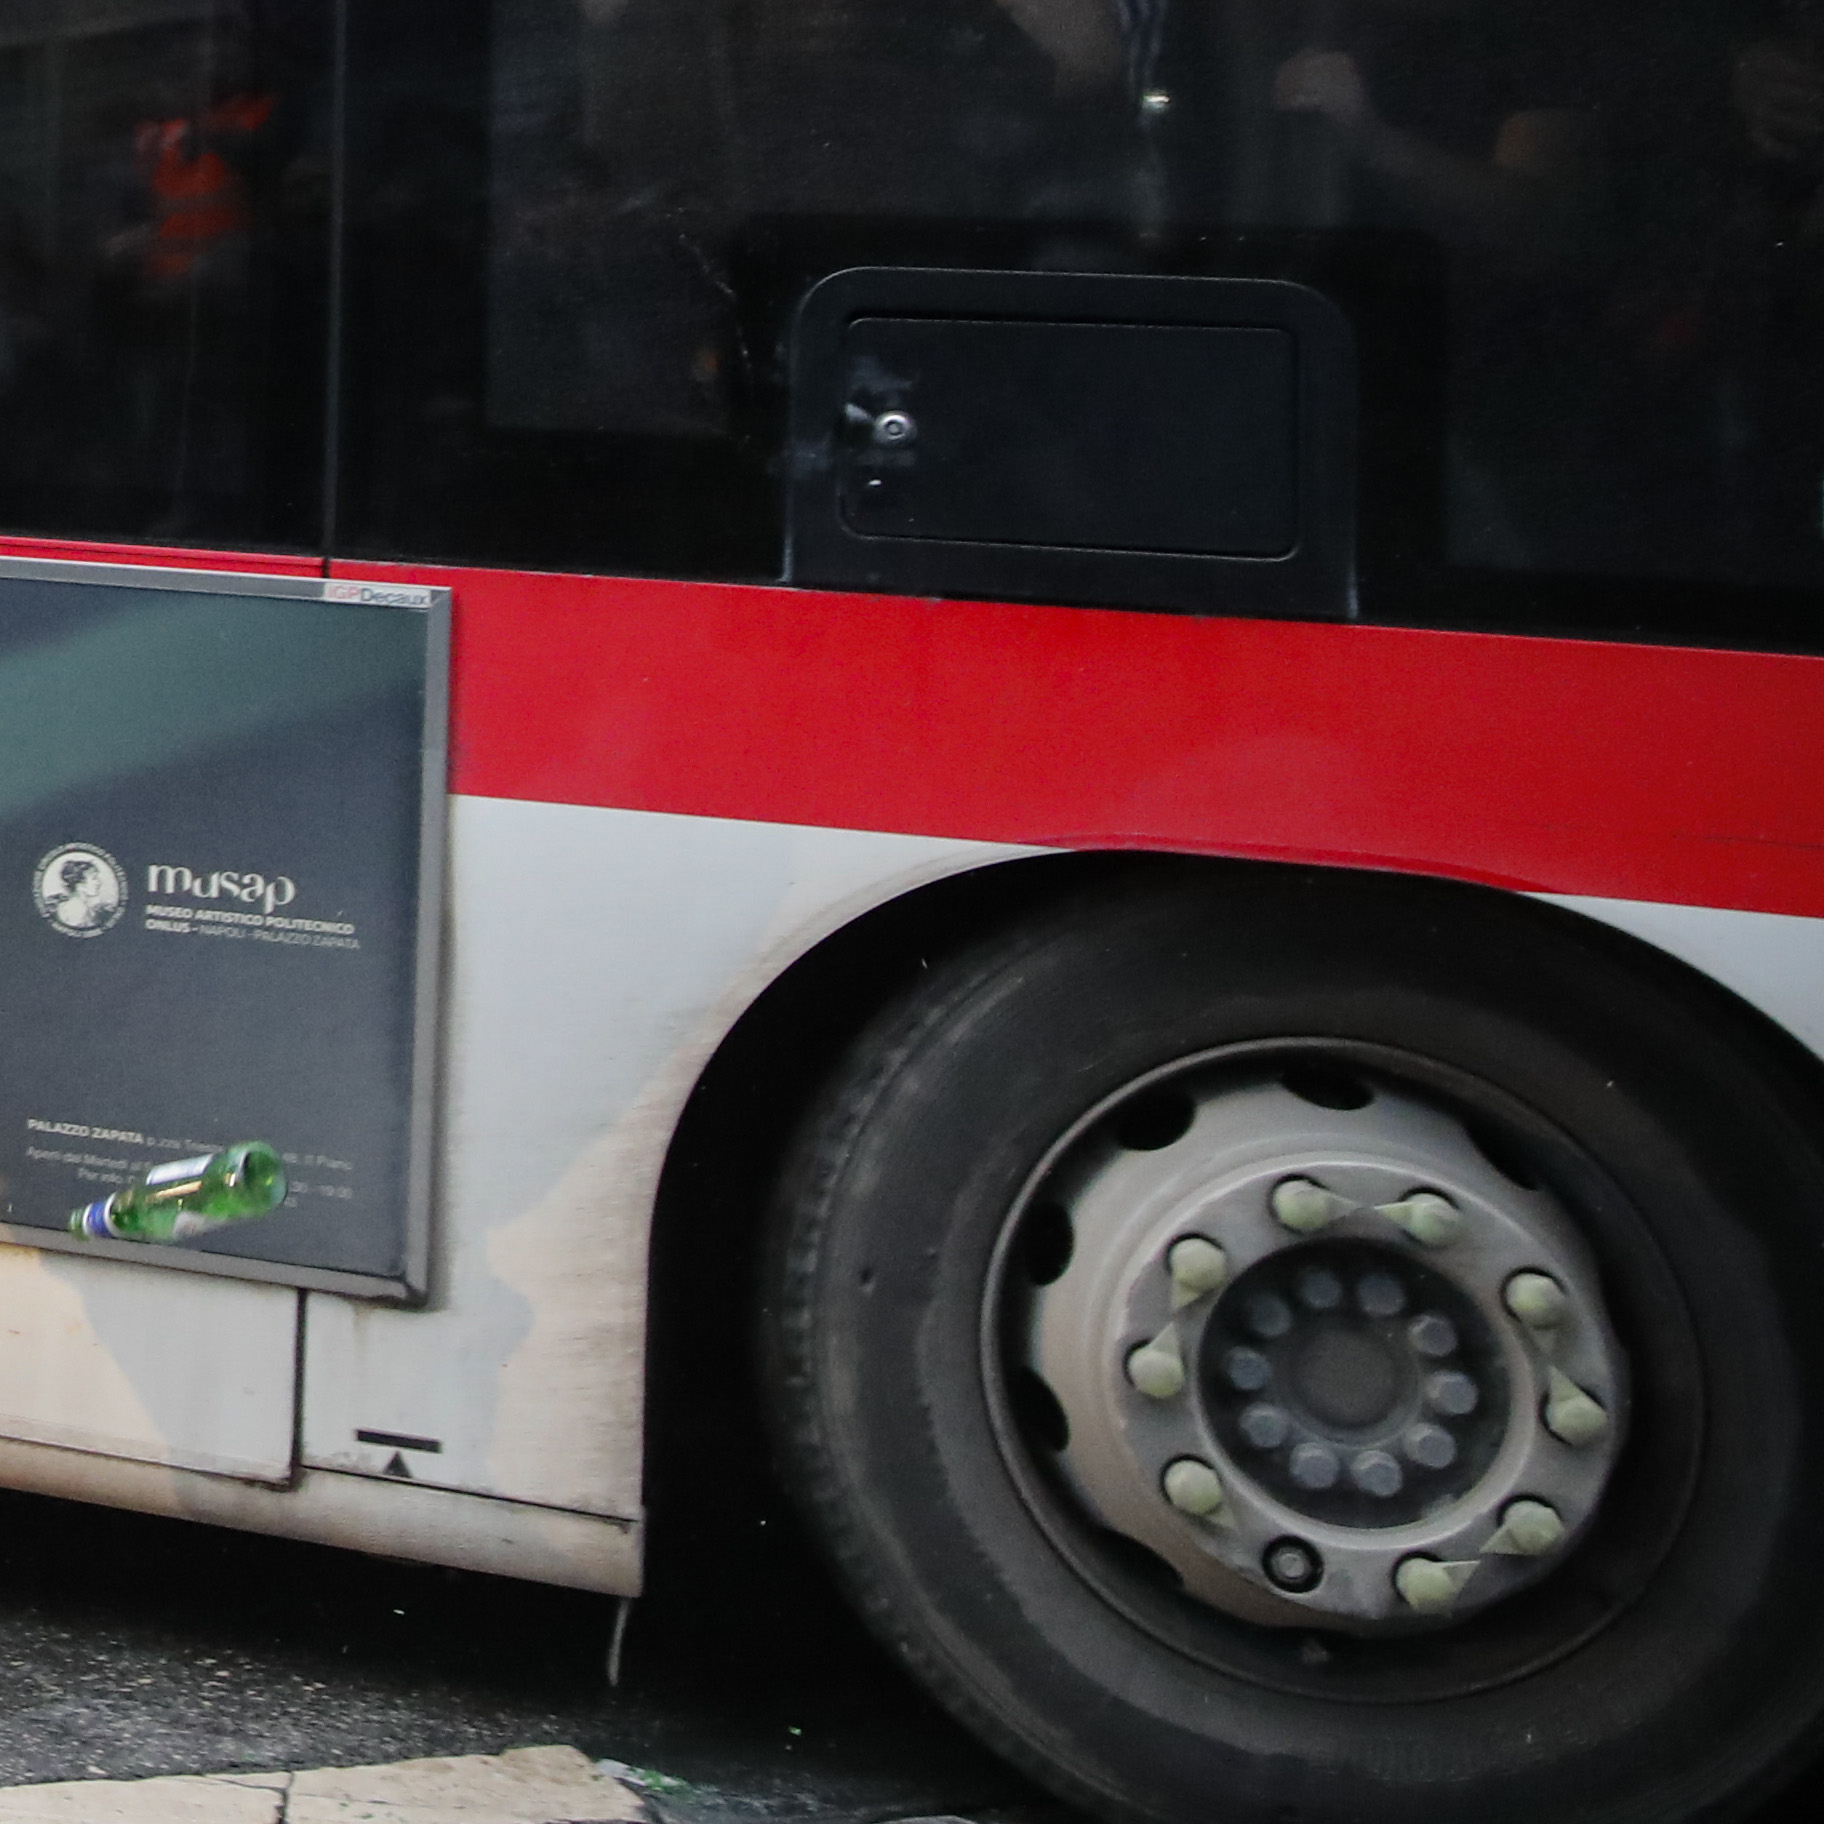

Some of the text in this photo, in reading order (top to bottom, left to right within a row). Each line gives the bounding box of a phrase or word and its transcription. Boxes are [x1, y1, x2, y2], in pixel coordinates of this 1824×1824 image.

[148, 863, 296, 915] musap
[145, 904, 356, 935] MUSEO ARTISTICO POLITECNICO
[26, 1118, 90, 1137] PALAZZO
[91, 1126, 145, 1145] ZAPATA
